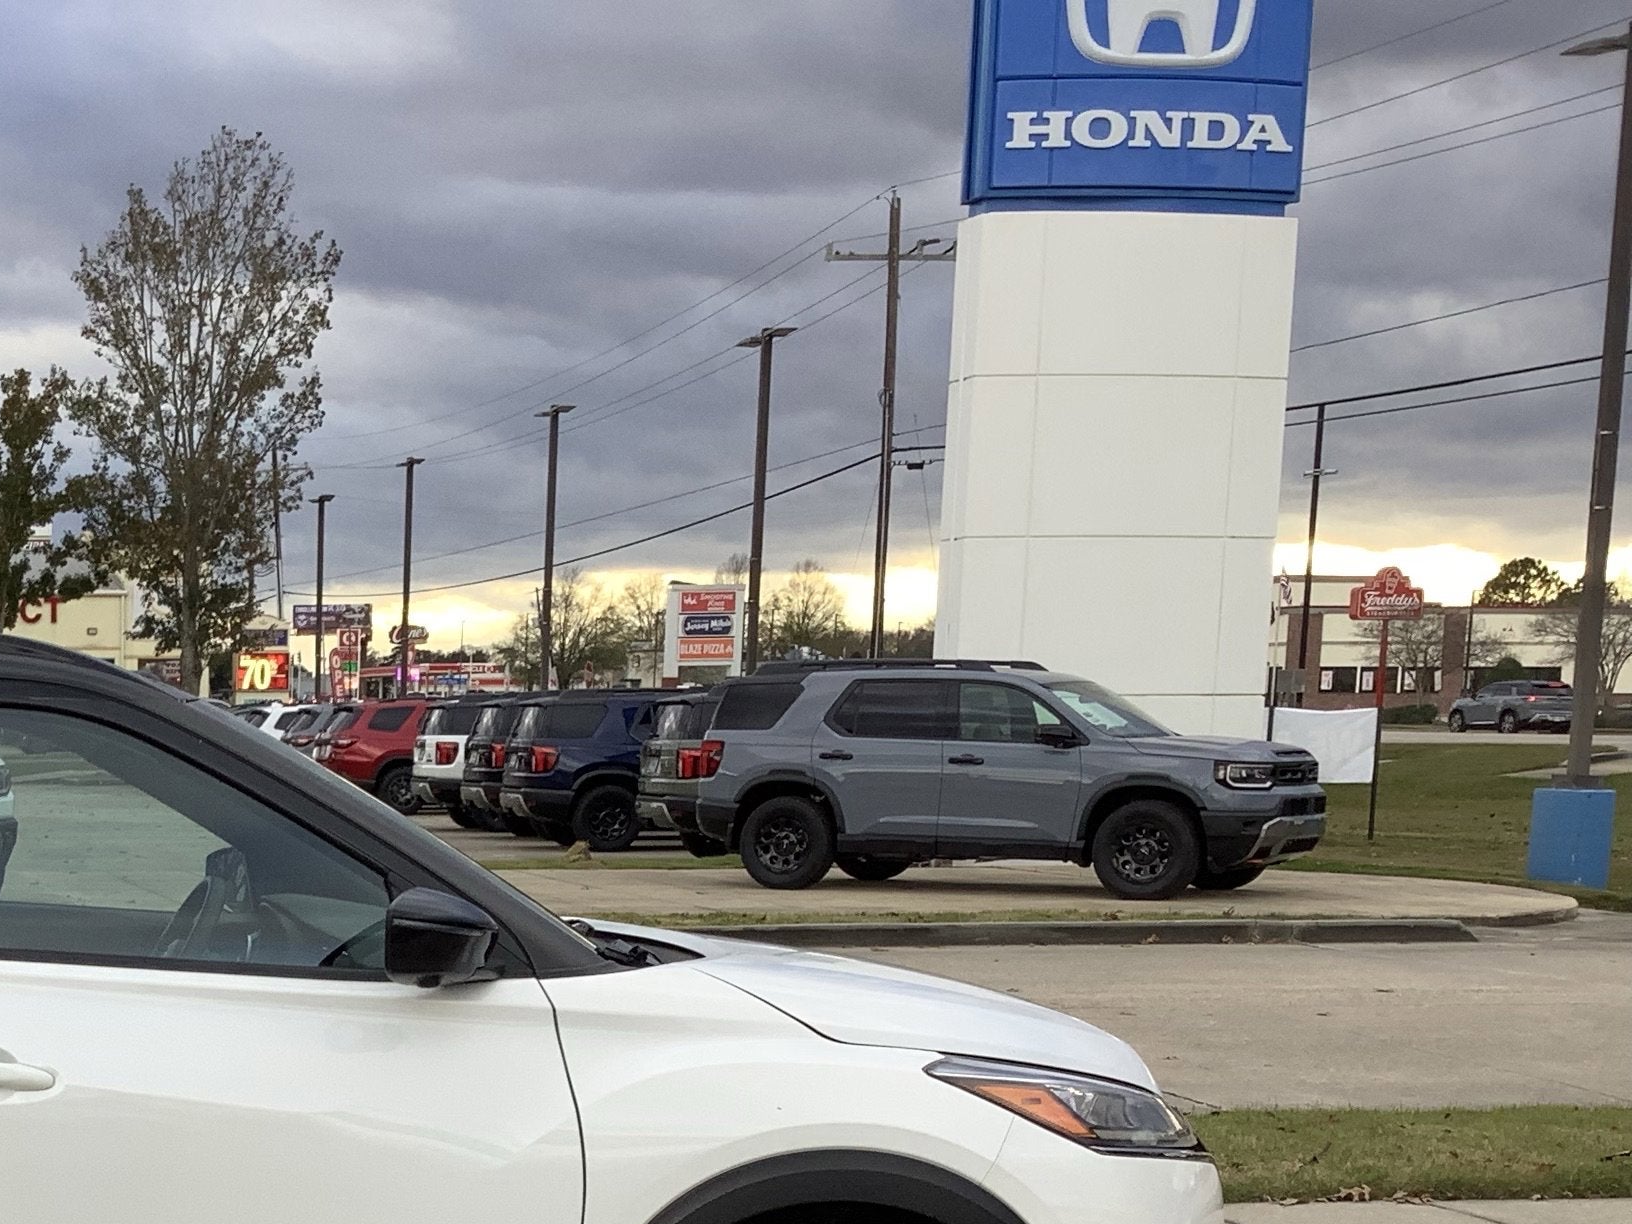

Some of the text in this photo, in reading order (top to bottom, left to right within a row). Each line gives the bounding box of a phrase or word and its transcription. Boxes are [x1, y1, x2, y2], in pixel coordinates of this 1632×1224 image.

[1005, 109, 1294, 153] HONDA
[1361, 591, 1420, 608] Freddy's
[392, 625, 428, 643] Cne's
[685, 622, 709, 631] Jersey
[680, 643, 725, 655] BLAZE PIZZA
